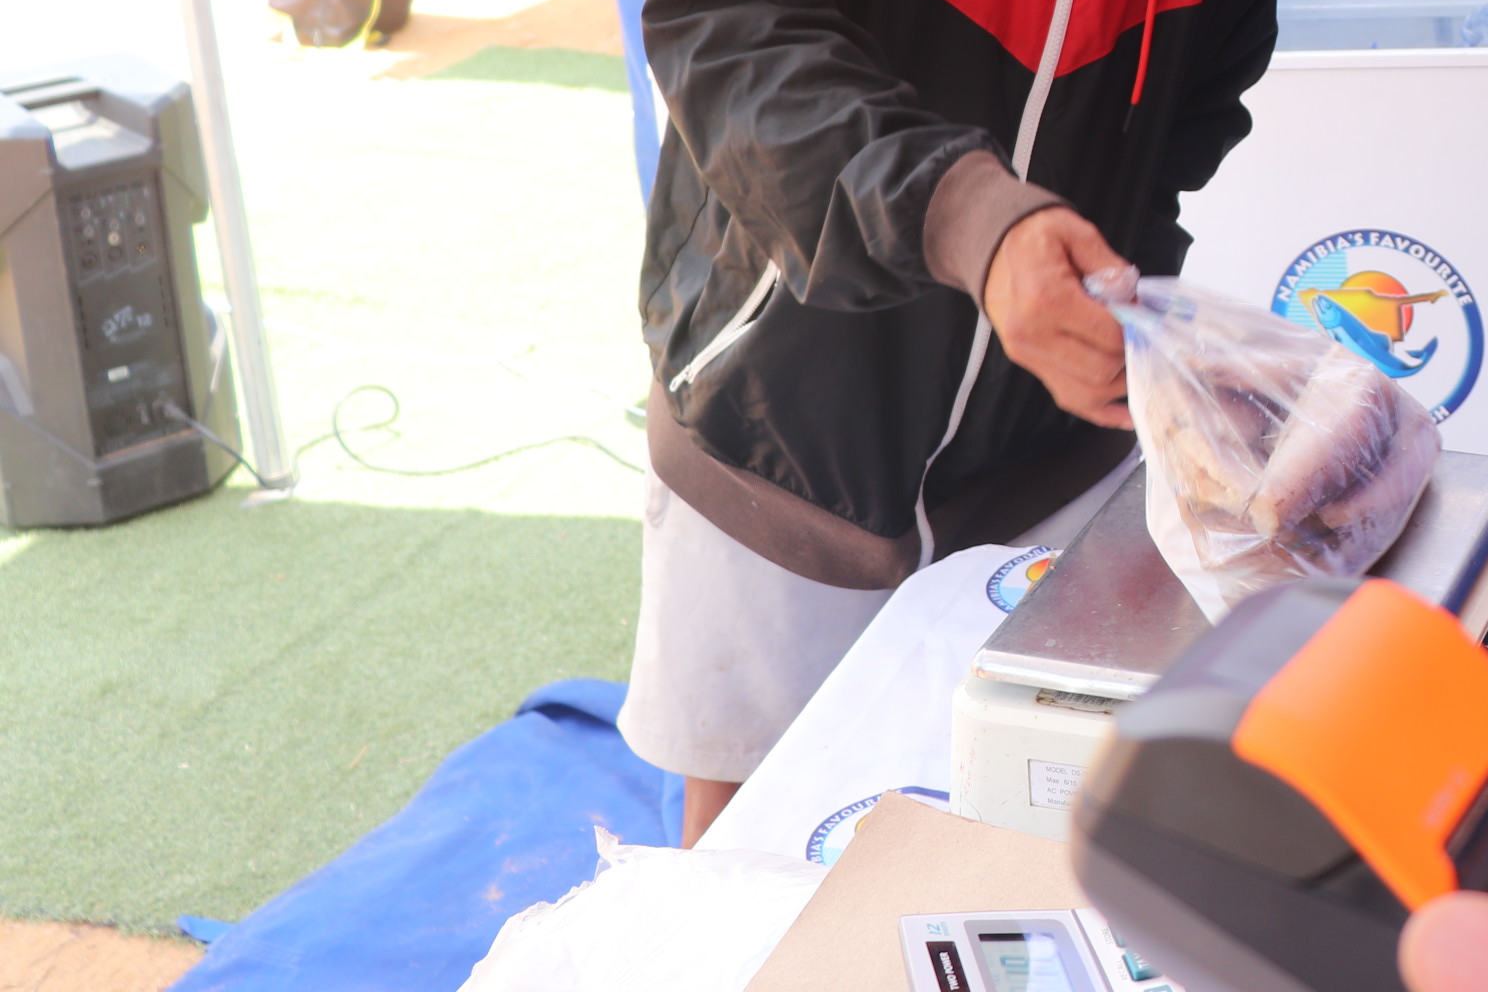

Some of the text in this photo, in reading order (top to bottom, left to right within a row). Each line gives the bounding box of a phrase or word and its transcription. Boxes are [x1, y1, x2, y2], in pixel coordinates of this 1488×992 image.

[1278, 231, 1474, 307] NAMIBIA'S FAVOURITE
[1046, 766, 1068, 775] MODEL
[810, 836, 824, 864] BIA'S
[939, 951, 959, 990] TWO POWER
